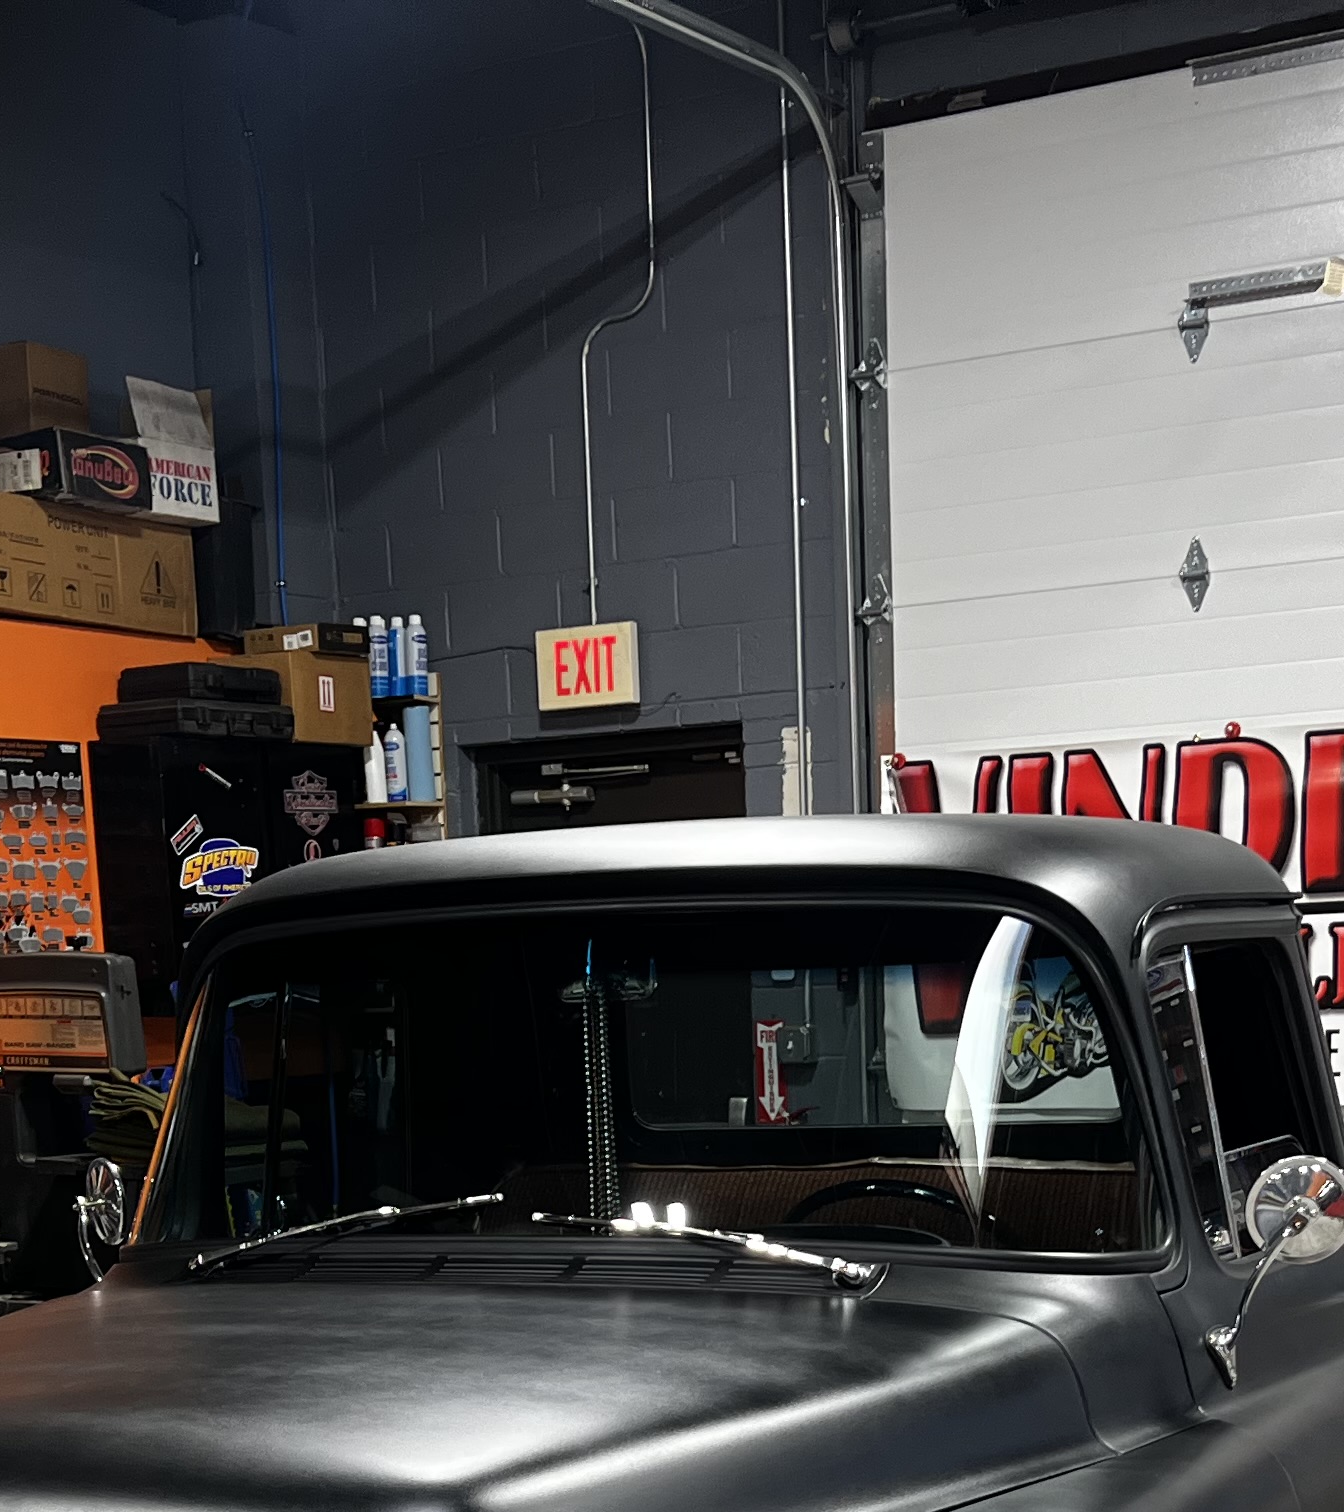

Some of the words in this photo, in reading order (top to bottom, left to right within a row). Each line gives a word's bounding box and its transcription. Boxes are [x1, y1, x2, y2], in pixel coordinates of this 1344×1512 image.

[150, 457, 211, 482] AMERICAN
[47, 516, 86, 535] POWER
[86, 523, 109, 538] UNIT
[553, 635, 617, 697] EXIT
[182, 849, 257, 888] SPECTRO
[6, 1055, 50, 1066] CRAFTSMAN
